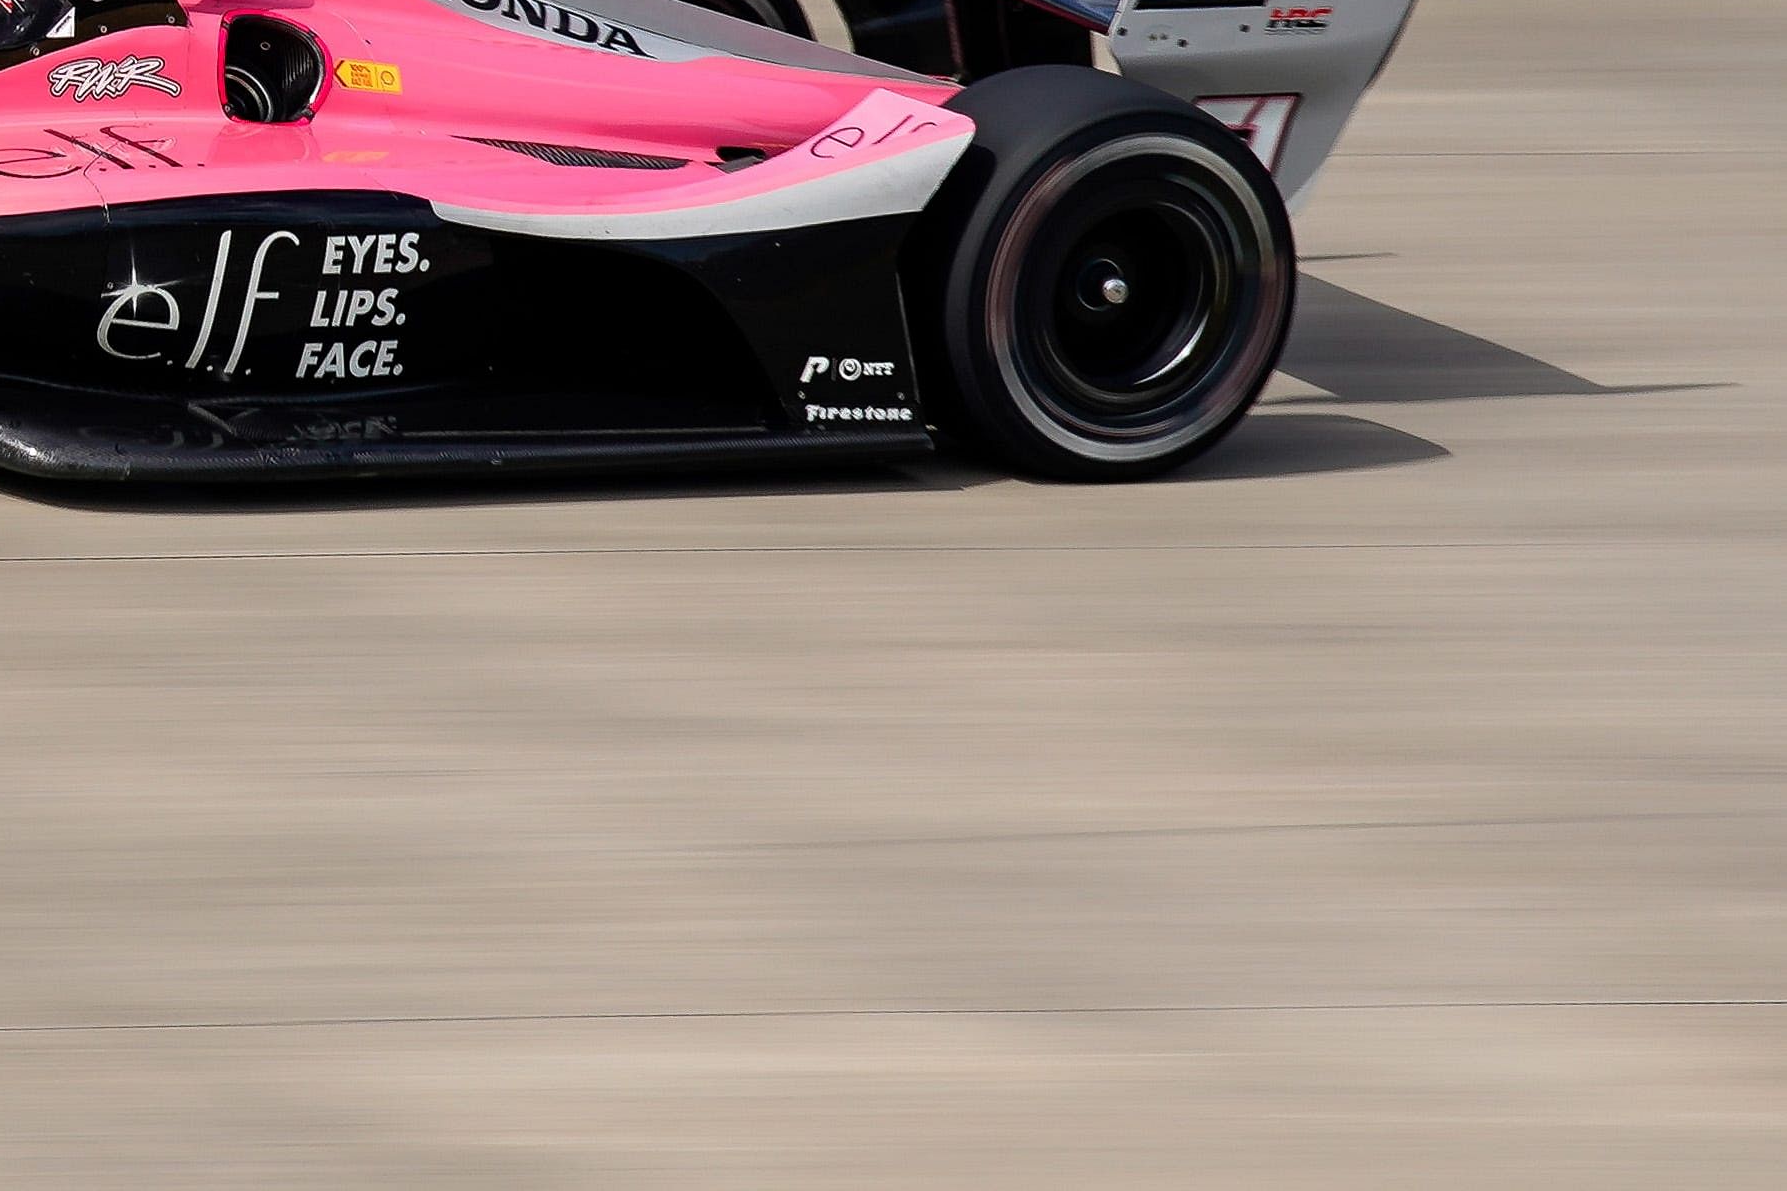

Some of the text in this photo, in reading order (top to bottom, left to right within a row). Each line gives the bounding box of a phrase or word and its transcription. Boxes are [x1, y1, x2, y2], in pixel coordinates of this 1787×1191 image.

[322, 233, 430, 275] EYES.
[310, 288, 406, 327] LIPS.
[295, 340, 404, 379] FACE.
[862, 362, 895, 376] NTT
[804, 403, 913, 422] Firestone
